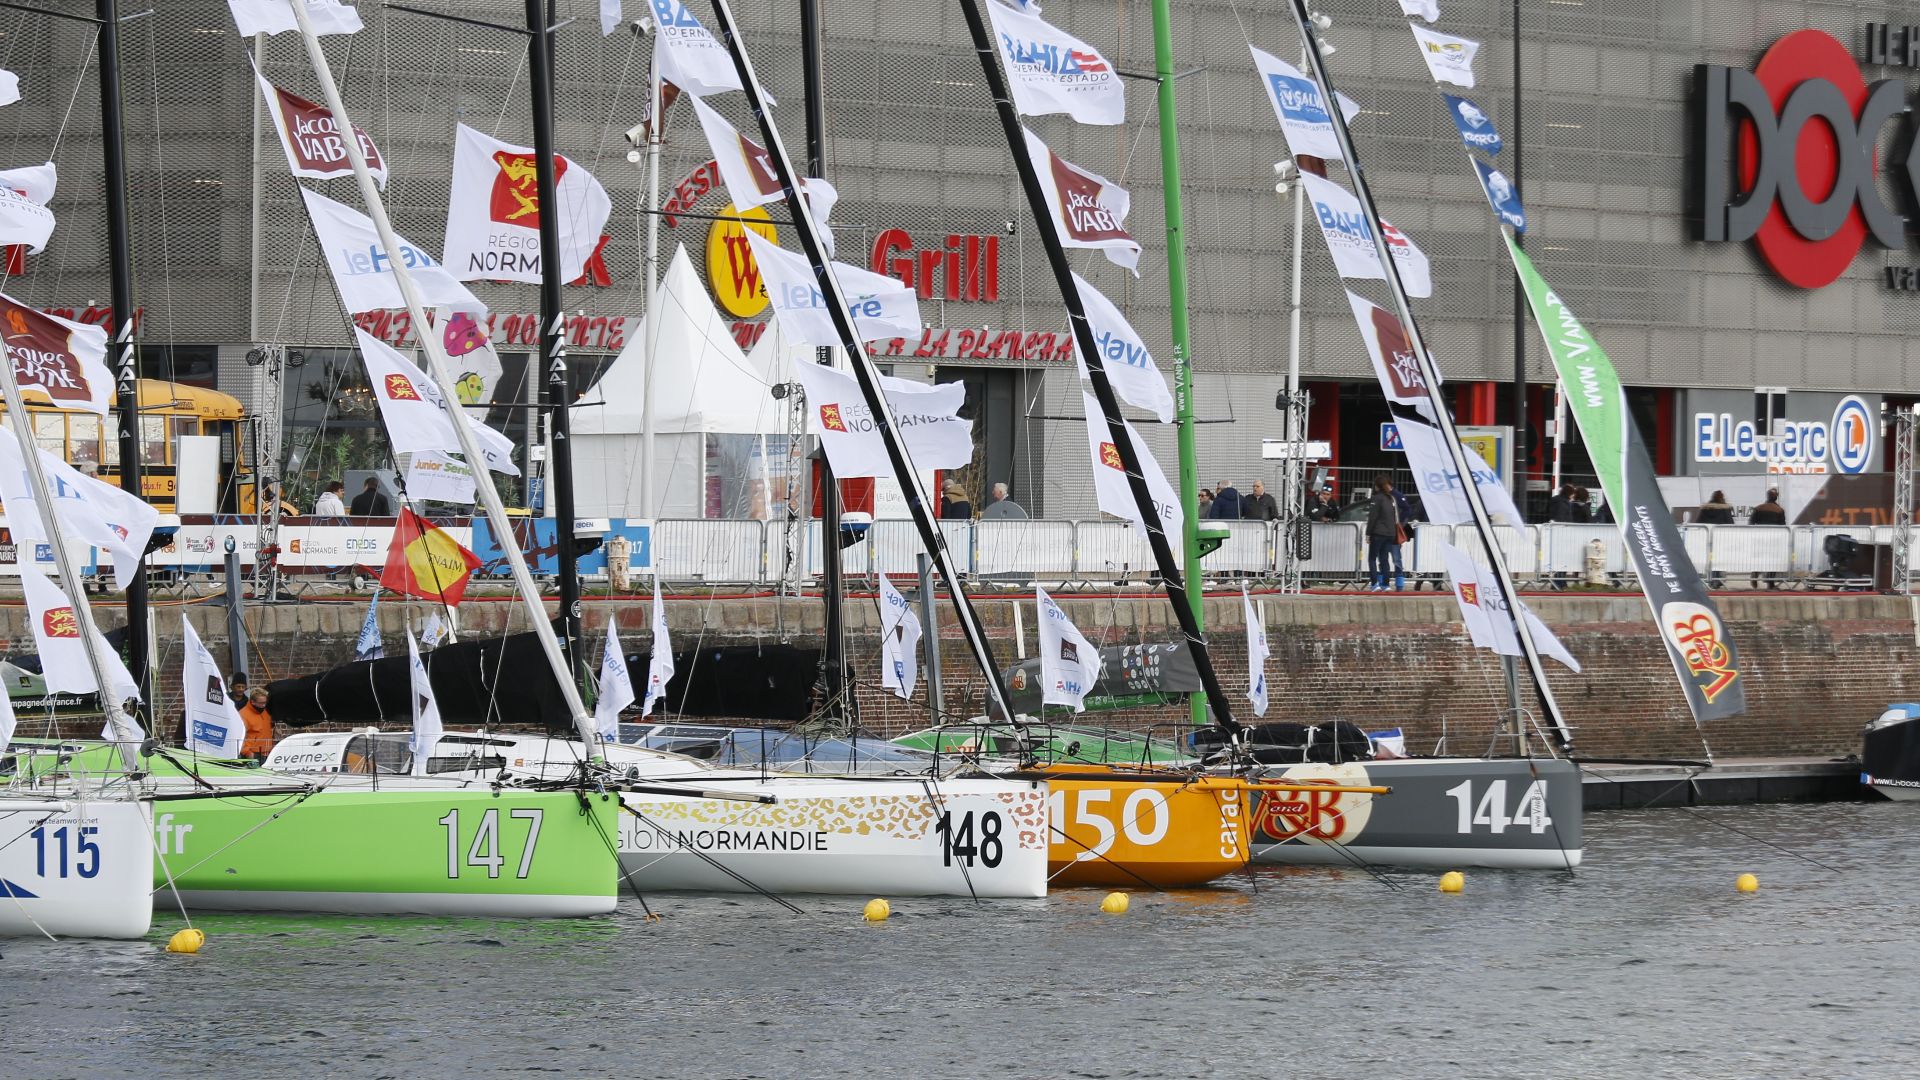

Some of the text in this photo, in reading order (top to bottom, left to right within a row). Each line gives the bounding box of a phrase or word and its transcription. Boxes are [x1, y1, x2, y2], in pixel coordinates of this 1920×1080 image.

[293, 131, 375, 162] VABE
[1692, 64, 1920, 250] DOC
[488, 232, 539, 249] RÉGIO
[1315, 202, 1372, 240] BAHI
[872, 228, 998, 302] Grill
[276, 750, 336, 765] evernex
[1049, 788, 1169, 861] 150
[1445, 779, 1552, 834] 144
[30, 826, 100, 879] 115
[438, 808, 544, 879] 147
[678, 830, 828, 851] NORMANDIE
[935, 810, 1003, 869] 148
